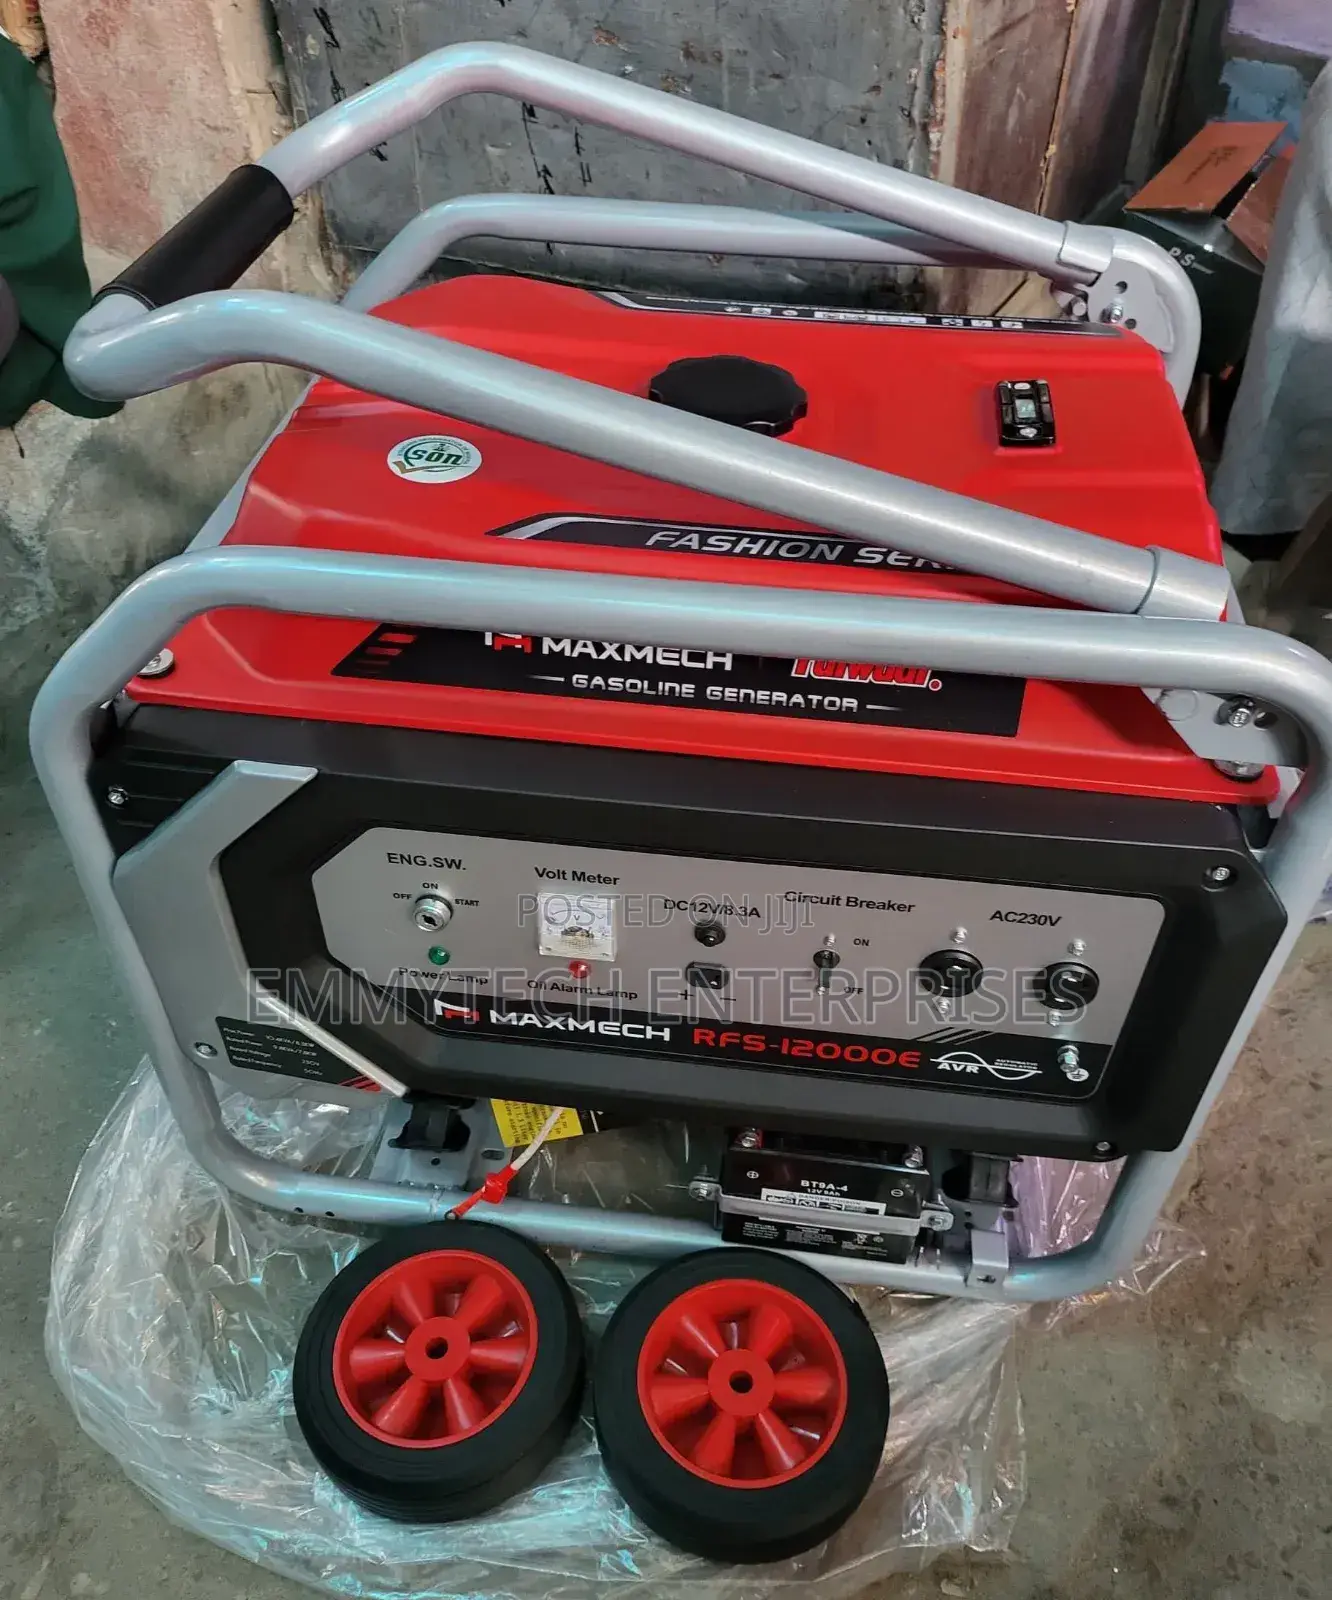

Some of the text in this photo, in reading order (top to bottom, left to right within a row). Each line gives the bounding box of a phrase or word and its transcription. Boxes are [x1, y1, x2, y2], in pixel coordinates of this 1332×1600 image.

[645, 530, 844, 561] FASHION
[541, 636, 733, 671] MAXMECH
[572, 673, 858, 713] GASOLINE GENERATOR
[387, 852, 467, 871] ENG.SW.
[534, 866, 620, 886] Volt Meter
[422, 882, 439, 890] ON
[392, 892, 480, 908] OFF START
[784, 890, 916, 914] Circuit Breaker
[989, 909, 1063, 927] AC230V
[853, 938, 870, 946] ON
[399, 967, 489, 986] Power Lamp
[550, 981, 593, 995] Alarm
[597, 986, 639, 1000] Lamp
[843, 986, 864, 995] OFF
[489, 1009, 671, 1042] MAXMECH
[693, 1027, 922, 1068] RFS-12000E
[936, 1062, 980, 1074] AVR
[801, 1179, 848, 1191] BT9A-4
